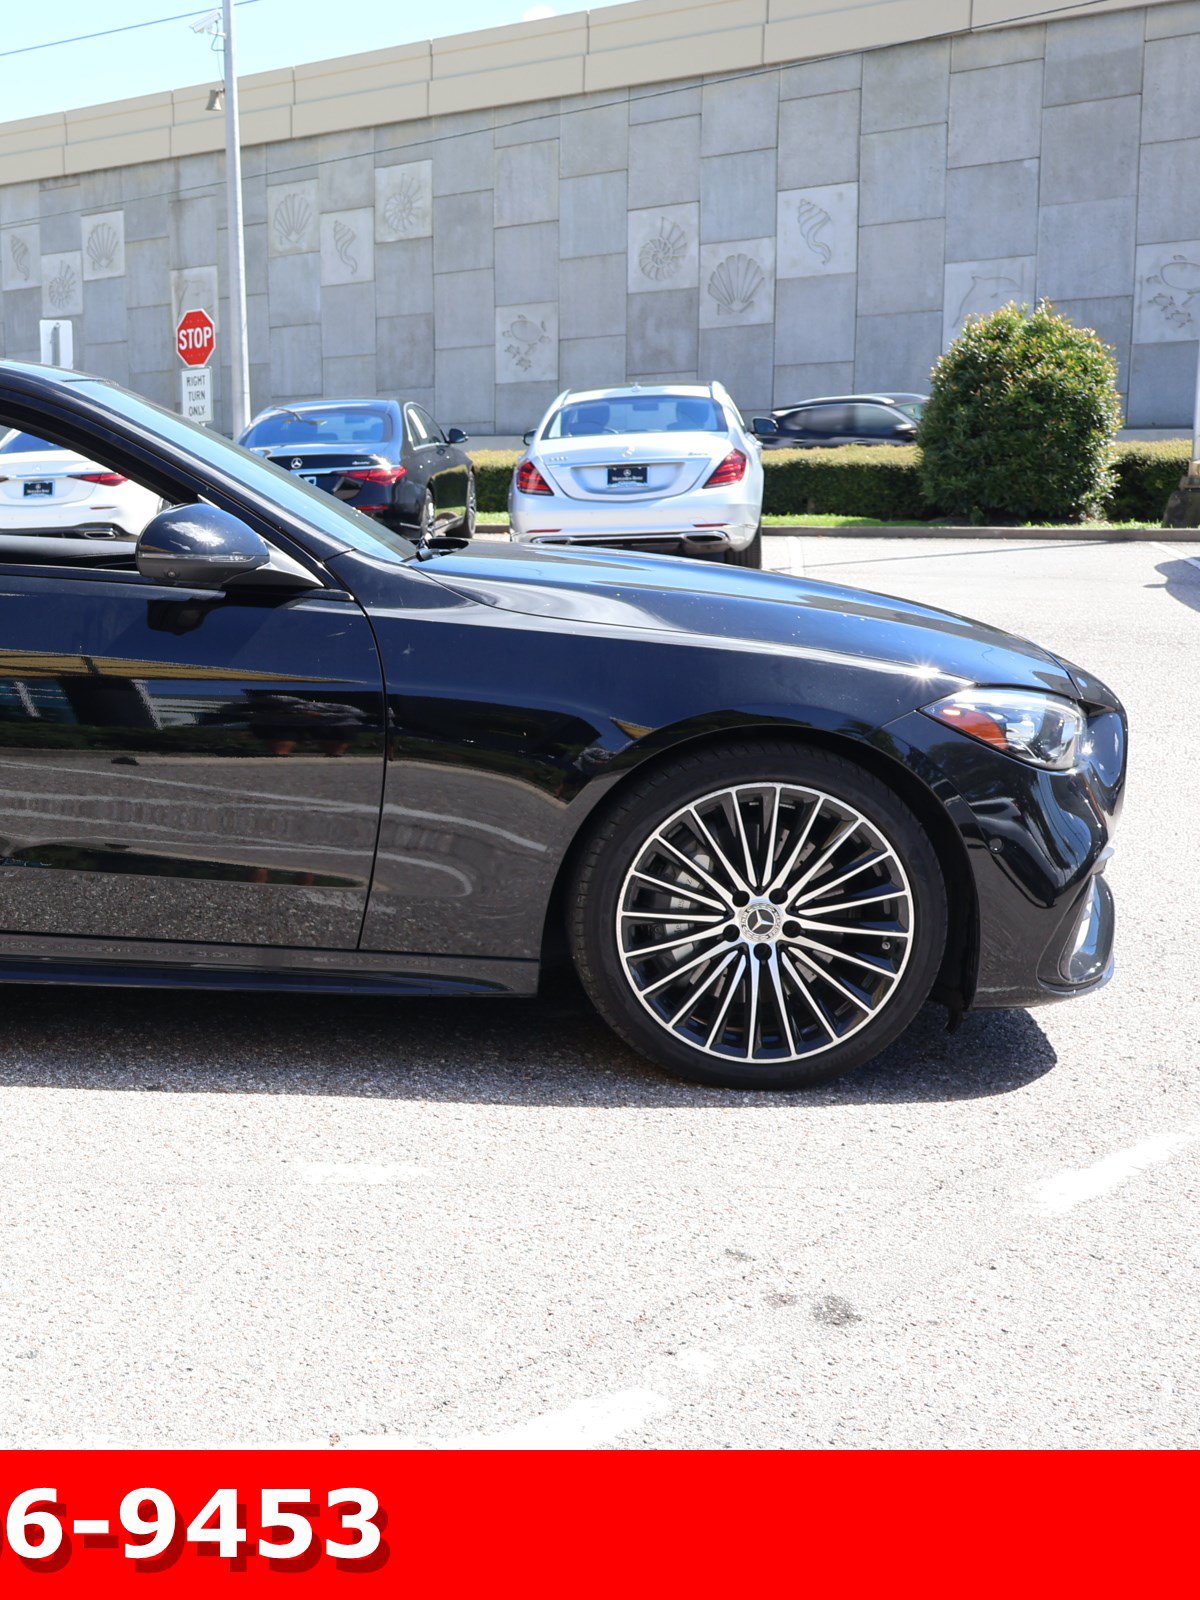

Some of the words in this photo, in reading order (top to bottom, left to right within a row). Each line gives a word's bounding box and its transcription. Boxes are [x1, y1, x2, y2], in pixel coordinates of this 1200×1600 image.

[179, 326, 212, 350] STOP
[186, 375, 206, 387] RIGHT
[188, 391, 206, 402] TURN
[188, 405, 206, 417] ONLY
